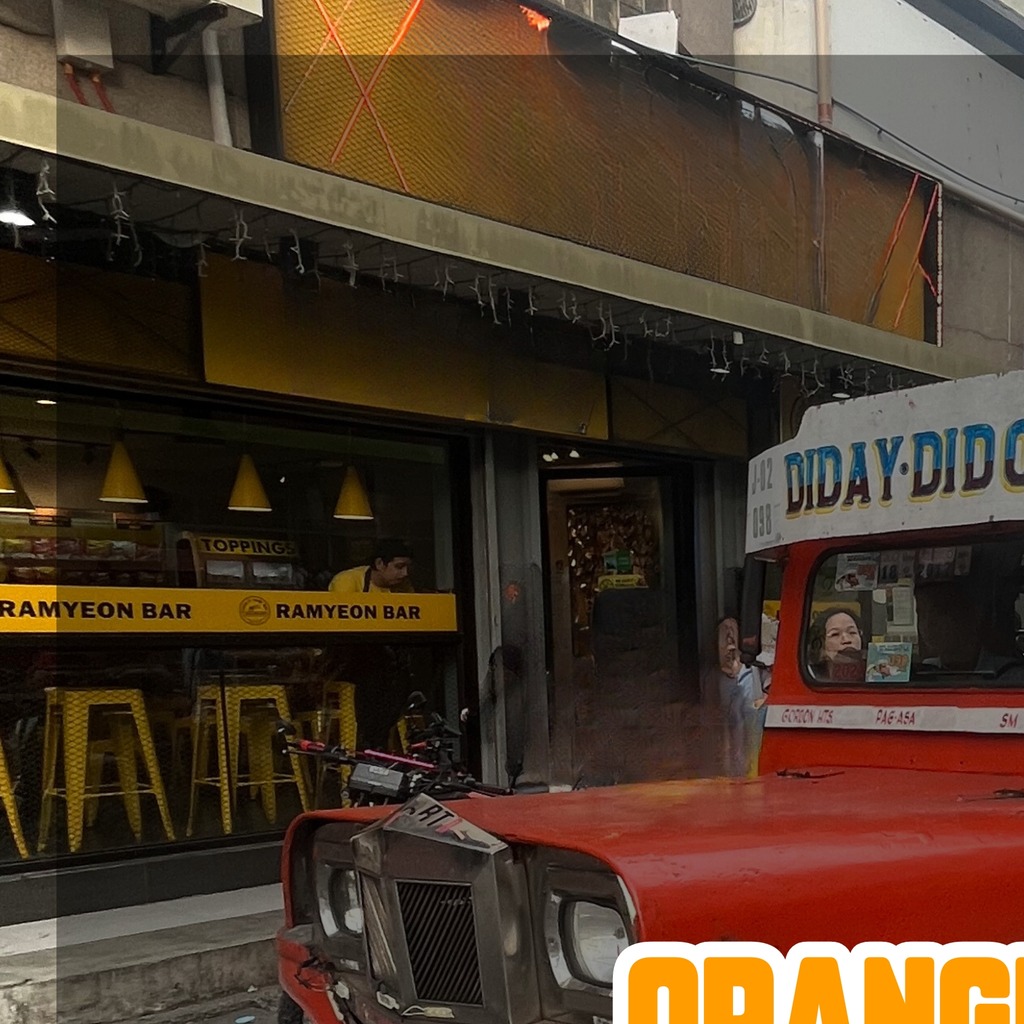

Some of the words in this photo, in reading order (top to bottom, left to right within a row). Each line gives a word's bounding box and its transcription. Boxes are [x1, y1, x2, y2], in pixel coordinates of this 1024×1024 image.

[784, 435, 904, 520] DIDAY
[200, 538, 296, 556] TOPPINGS
[0, 600, 134, 619] RAMYEON
[142, 603, 192, 620] BAR
[276, 603, 377, 619] RAMYEON
[383, 605, 421, 620] BAR
[1000, 713, 1018, 728] SM
